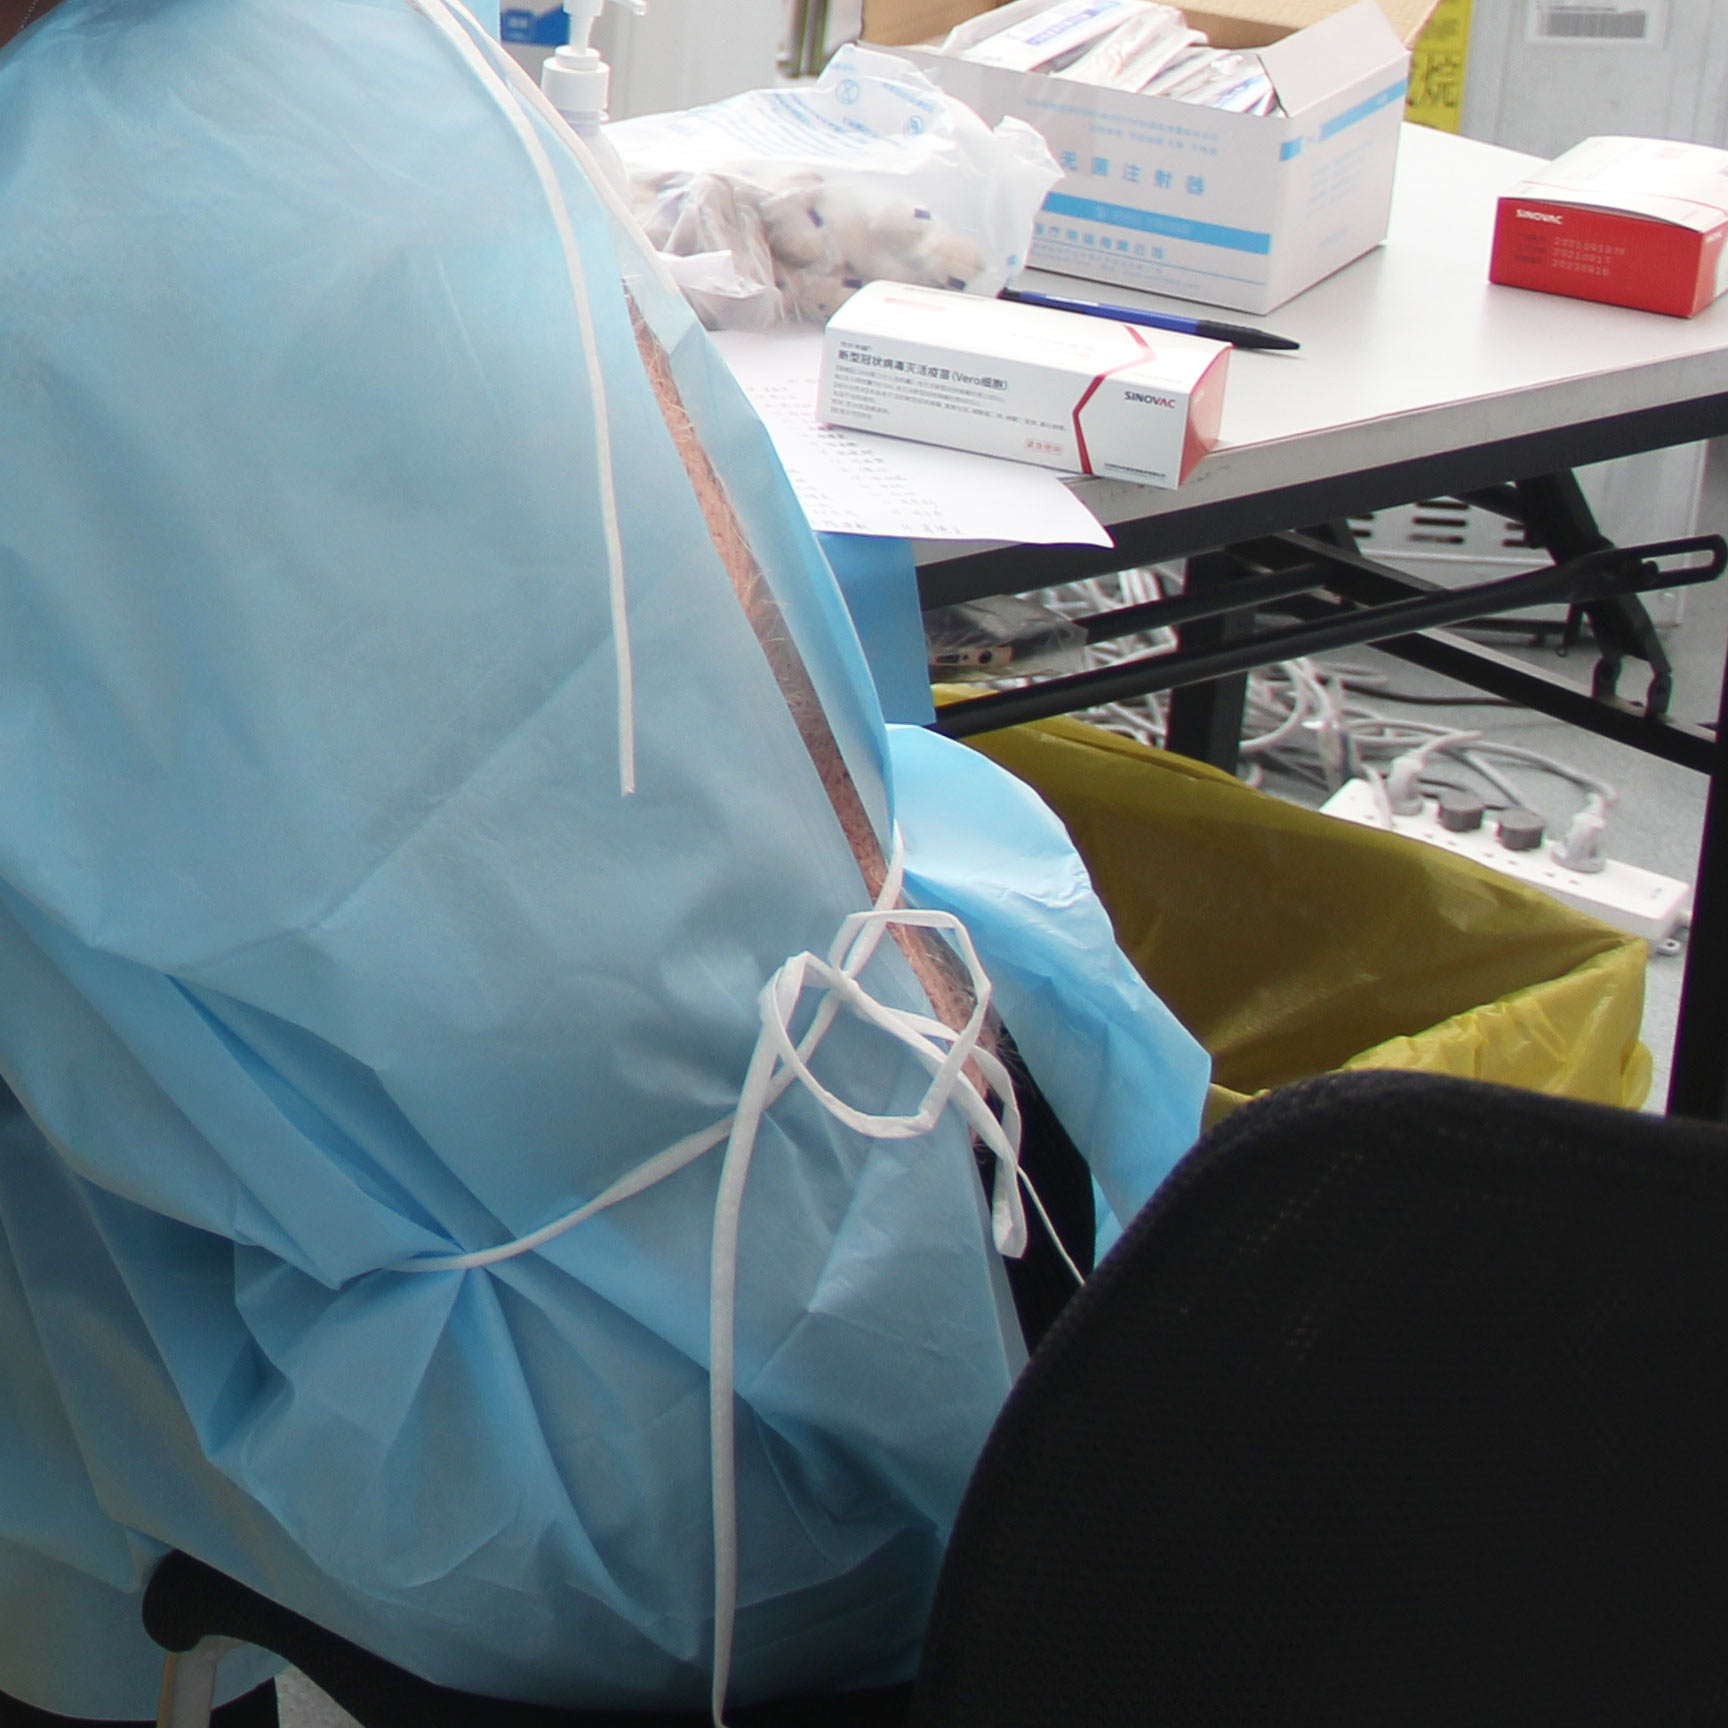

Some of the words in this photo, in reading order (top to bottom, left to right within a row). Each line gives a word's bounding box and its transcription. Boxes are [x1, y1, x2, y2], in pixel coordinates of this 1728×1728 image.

[1060, 150, 1207, 195] 无菌注射器
[1515, 208, 1564, 226] SINOVAC
[1124, 390, 1176, 410] SINOVAC
